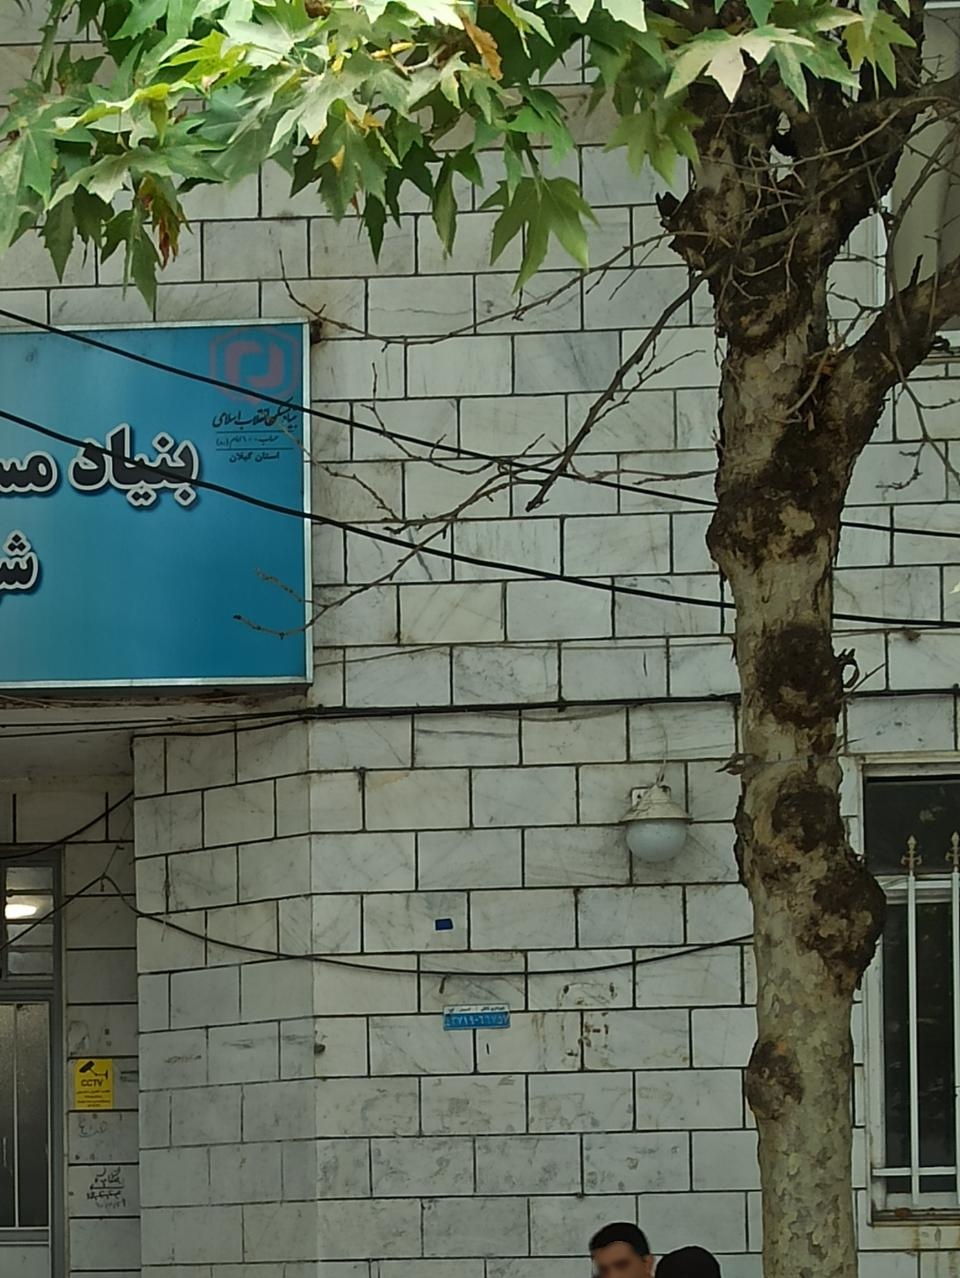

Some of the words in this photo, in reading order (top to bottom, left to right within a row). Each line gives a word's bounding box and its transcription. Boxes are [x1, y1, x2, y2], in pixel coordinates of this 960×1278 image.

[229, 451, 252, 463] گیلان
[255, 451, 280, 463] استان
[70, 423, 199, 507] بنیاد
[81, 1079, 103, 1087] CCTV
